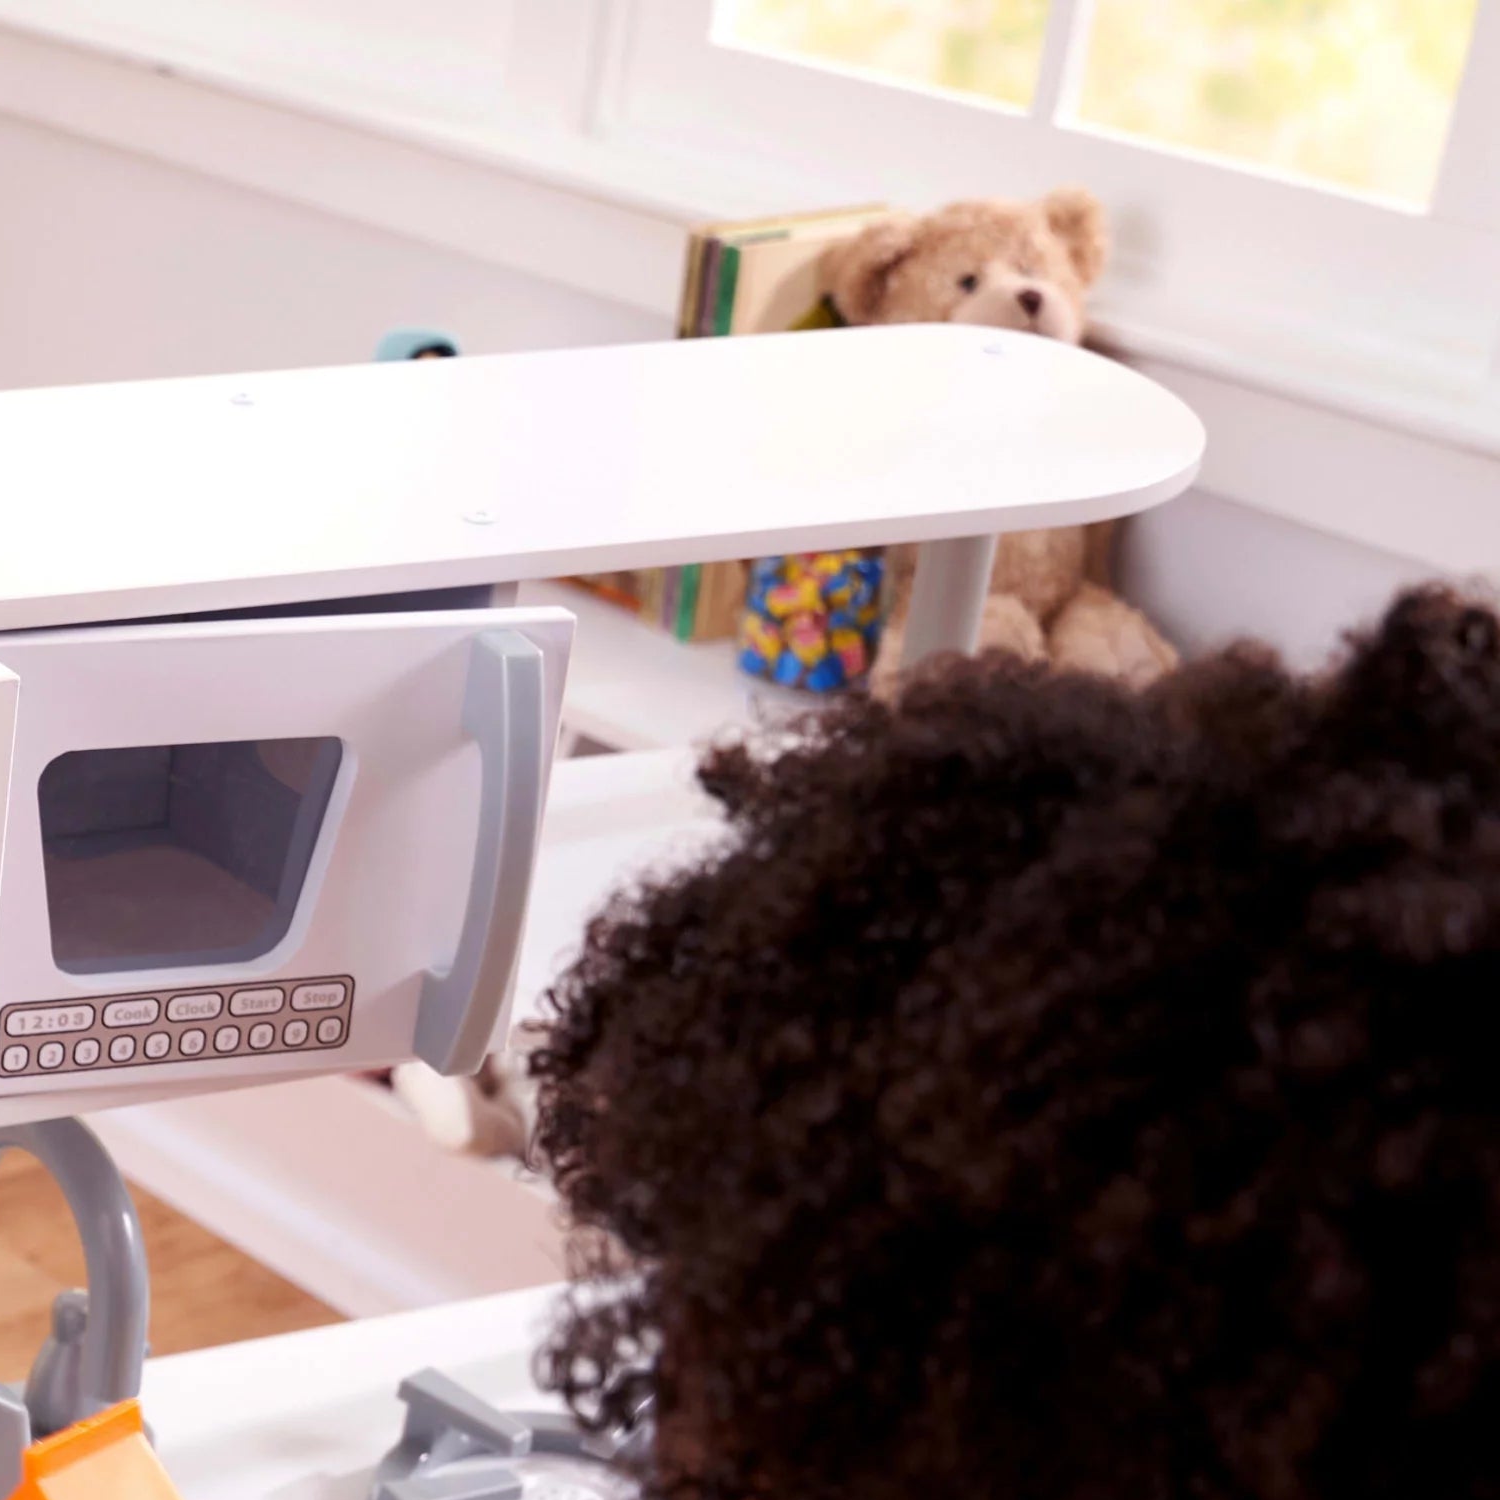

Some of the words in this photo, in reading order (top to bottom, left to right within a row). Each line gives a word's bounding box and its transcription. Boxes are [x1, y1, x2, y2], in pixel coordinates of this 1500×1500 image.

[241, 996, 278, 1011] Start
[303, 990, 338, 1006] Stop
[113, 1005, 151, 1021] Cook
[175, 1001, 216, 1017] Clock
